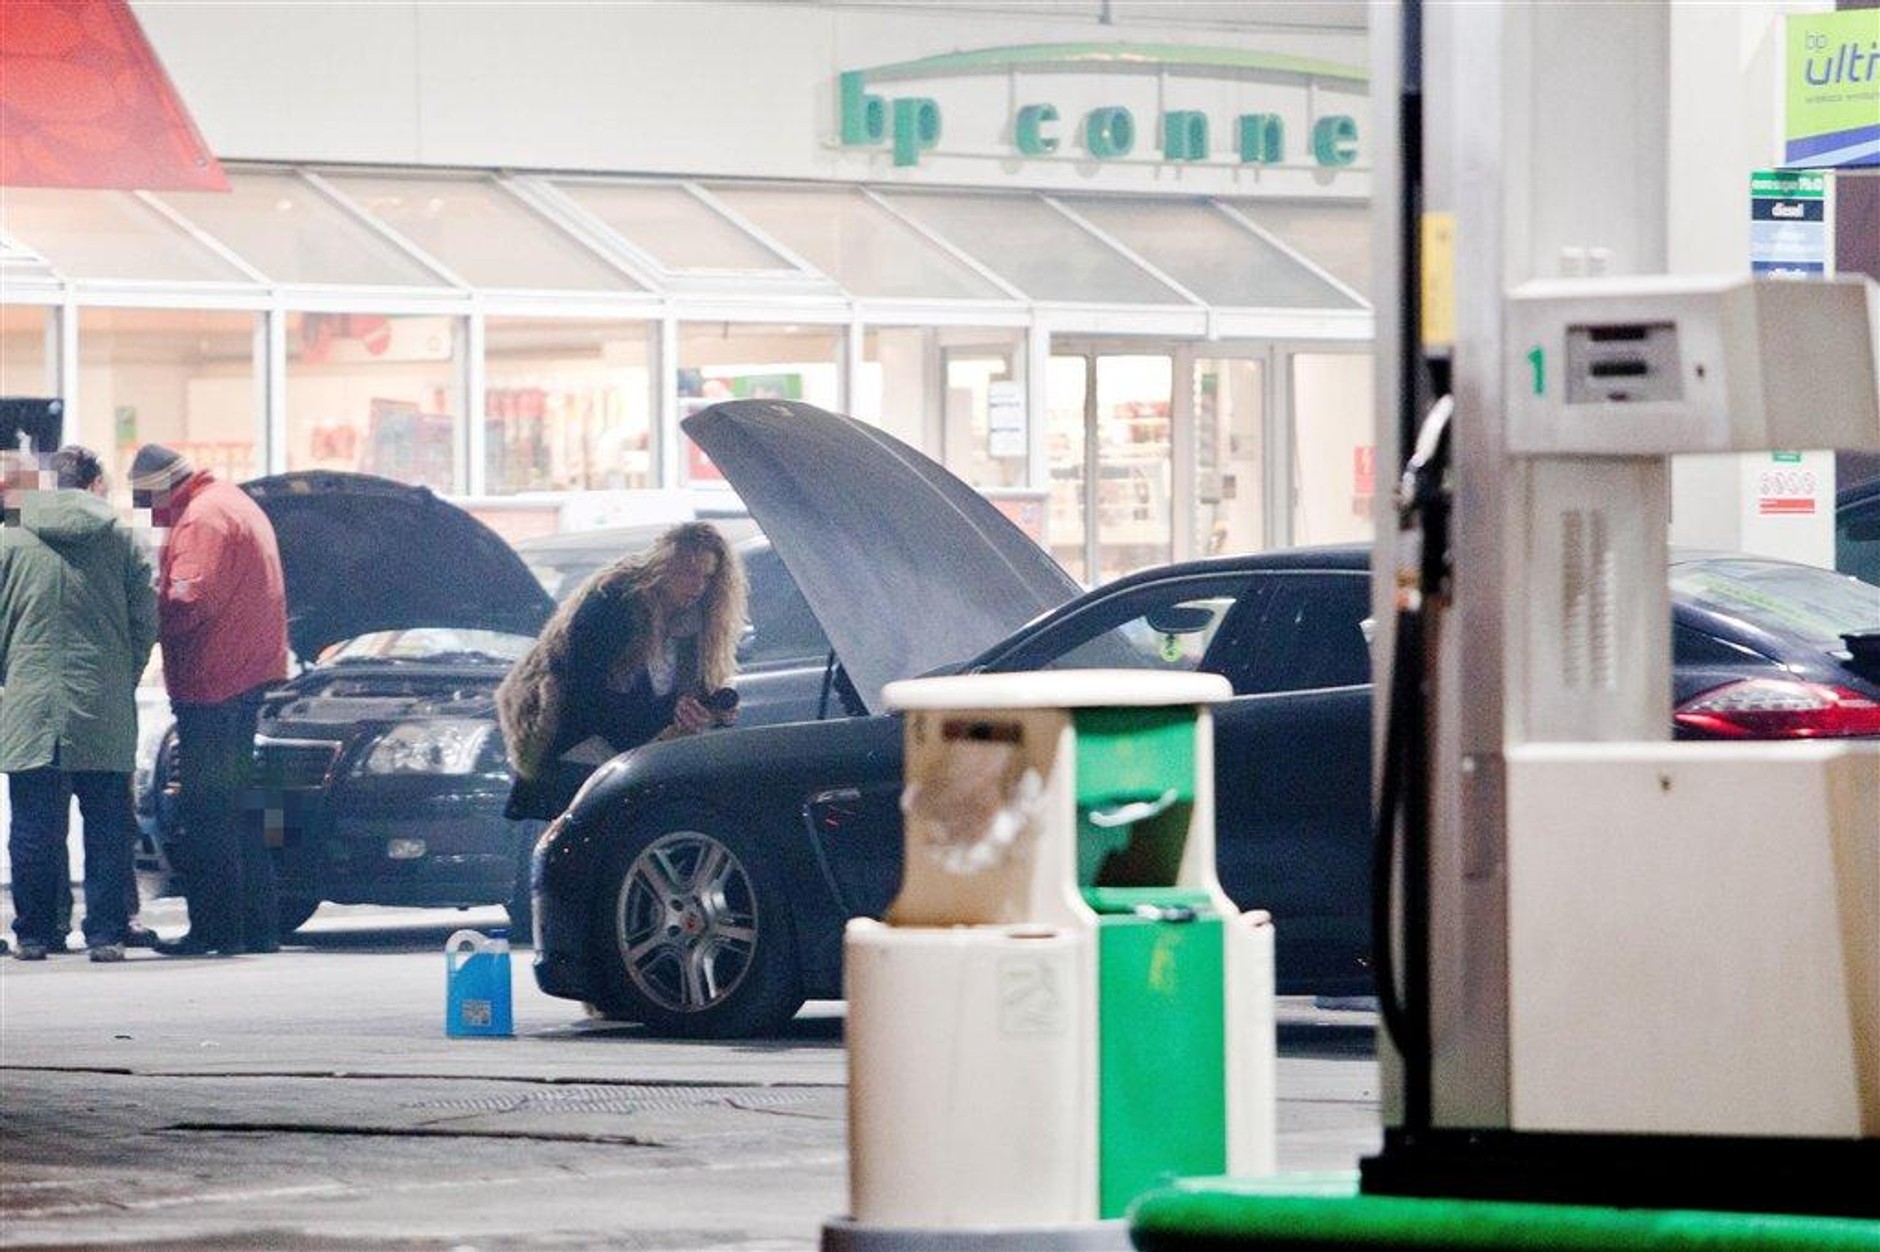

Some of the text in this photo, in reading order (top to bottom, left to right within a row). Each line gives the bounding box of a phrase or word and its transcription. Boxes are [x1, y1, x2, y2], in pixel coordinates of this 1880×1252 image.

[840, 70, 1358, 167] bp conne
[1527, 345, 1545, 395] 1
